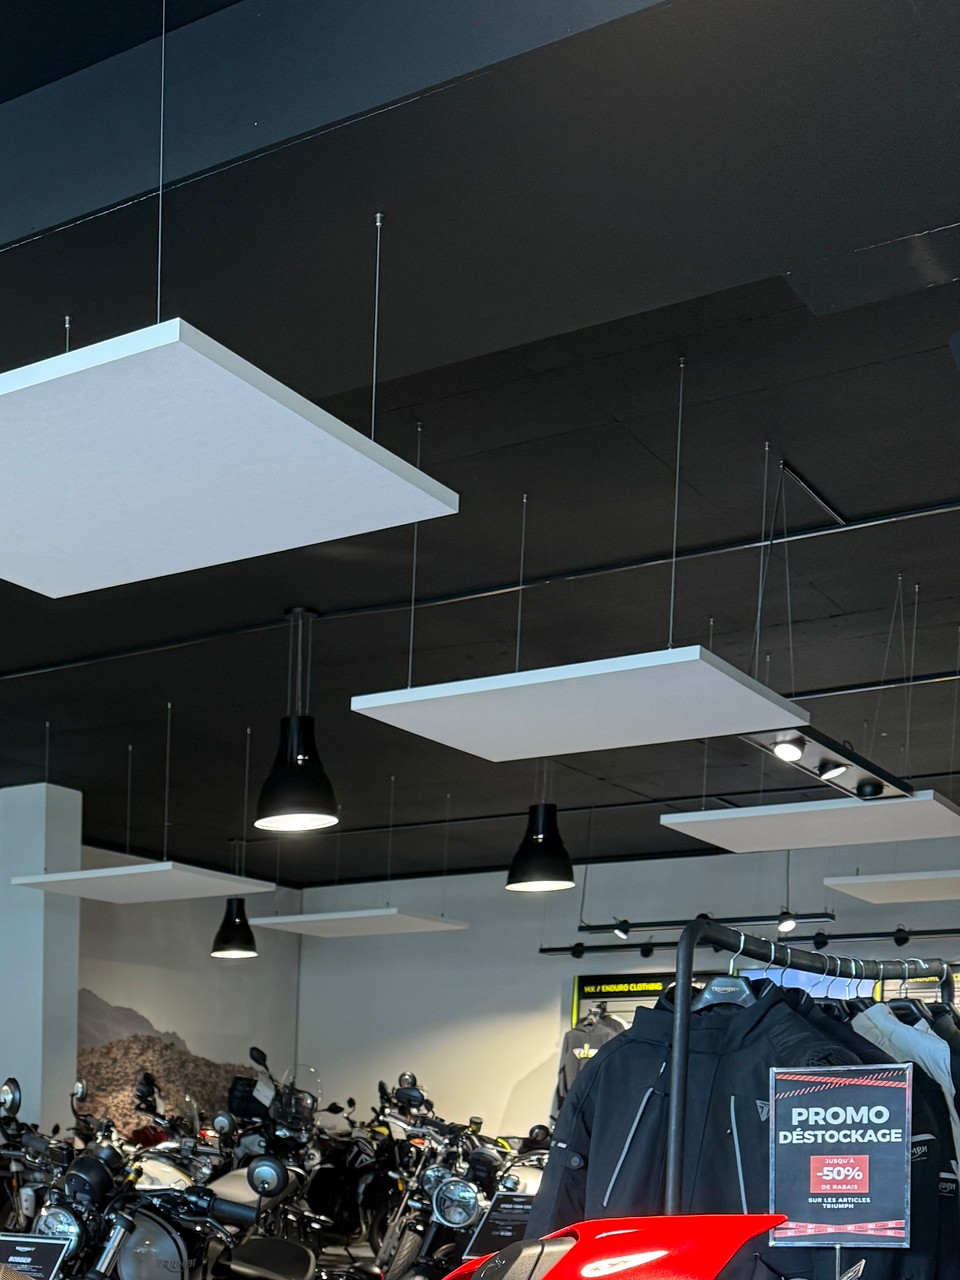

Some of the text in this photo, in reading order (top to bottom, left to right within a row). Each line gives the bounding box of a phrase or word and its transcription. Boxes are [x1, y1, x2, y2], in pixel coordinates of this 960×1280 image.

[791, 1105, 890, 1126] PROMO
[778, 1128, 903, 1144] DÉSTOCKAGE
[816, 1166, 863, 1180] -50%
